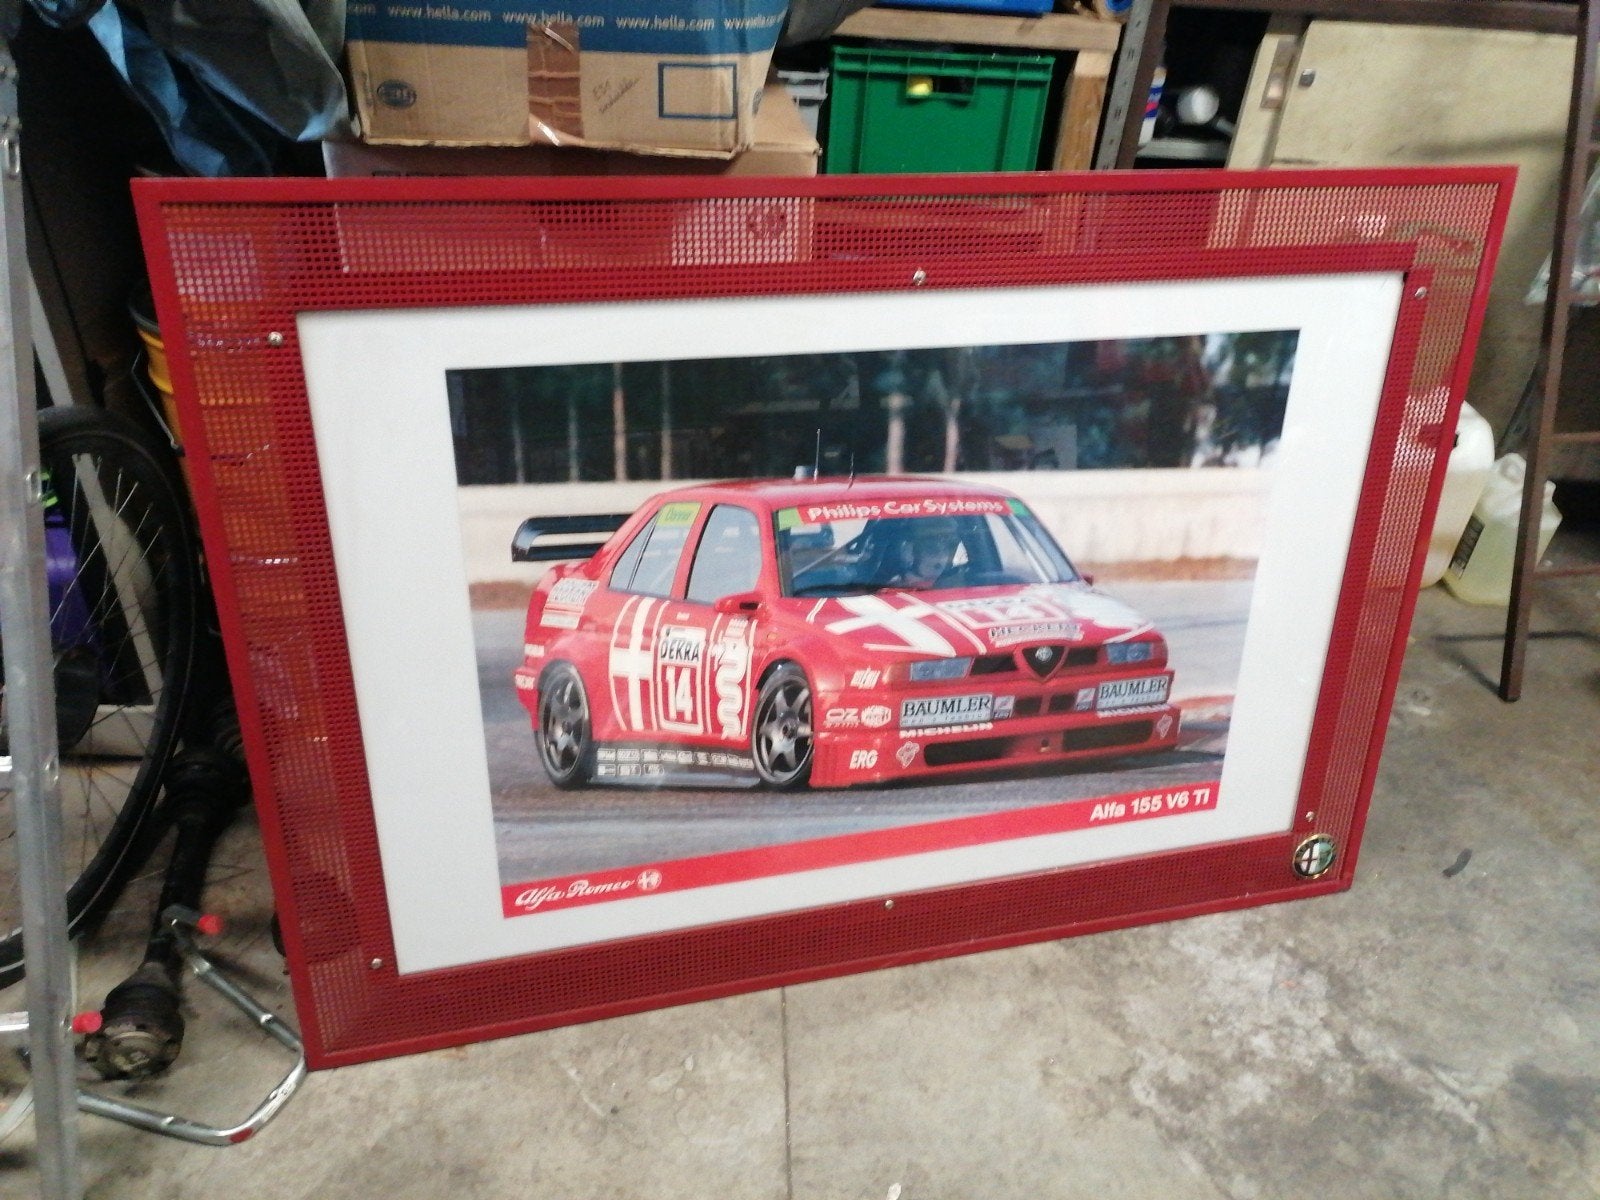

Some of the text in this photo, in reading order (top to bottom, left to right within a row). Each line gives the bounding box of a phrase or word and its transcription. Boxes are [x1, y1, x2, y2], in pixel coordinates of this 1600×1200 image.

[387, 5, 491, 22] www.hella.com
[502, 11, 604, 28] www.hella.com
[616, 15, 714, 31] www.hella.com
[807, 499, 1004, 522] Philips Car Systems
[660, 639, 700, 662] DEKRA
[666, 666, 693, 722] 14
[899, 722, 993, 739] MICHELIN
[849, 749, 878, 769] ERG
[1089, 801, 1126, 822] Alfa
[1130, 794, 1162, 815] 155
[1166, 790, 1189, 809] V6
[515, 879, 635, 911] Alfa Romeo
